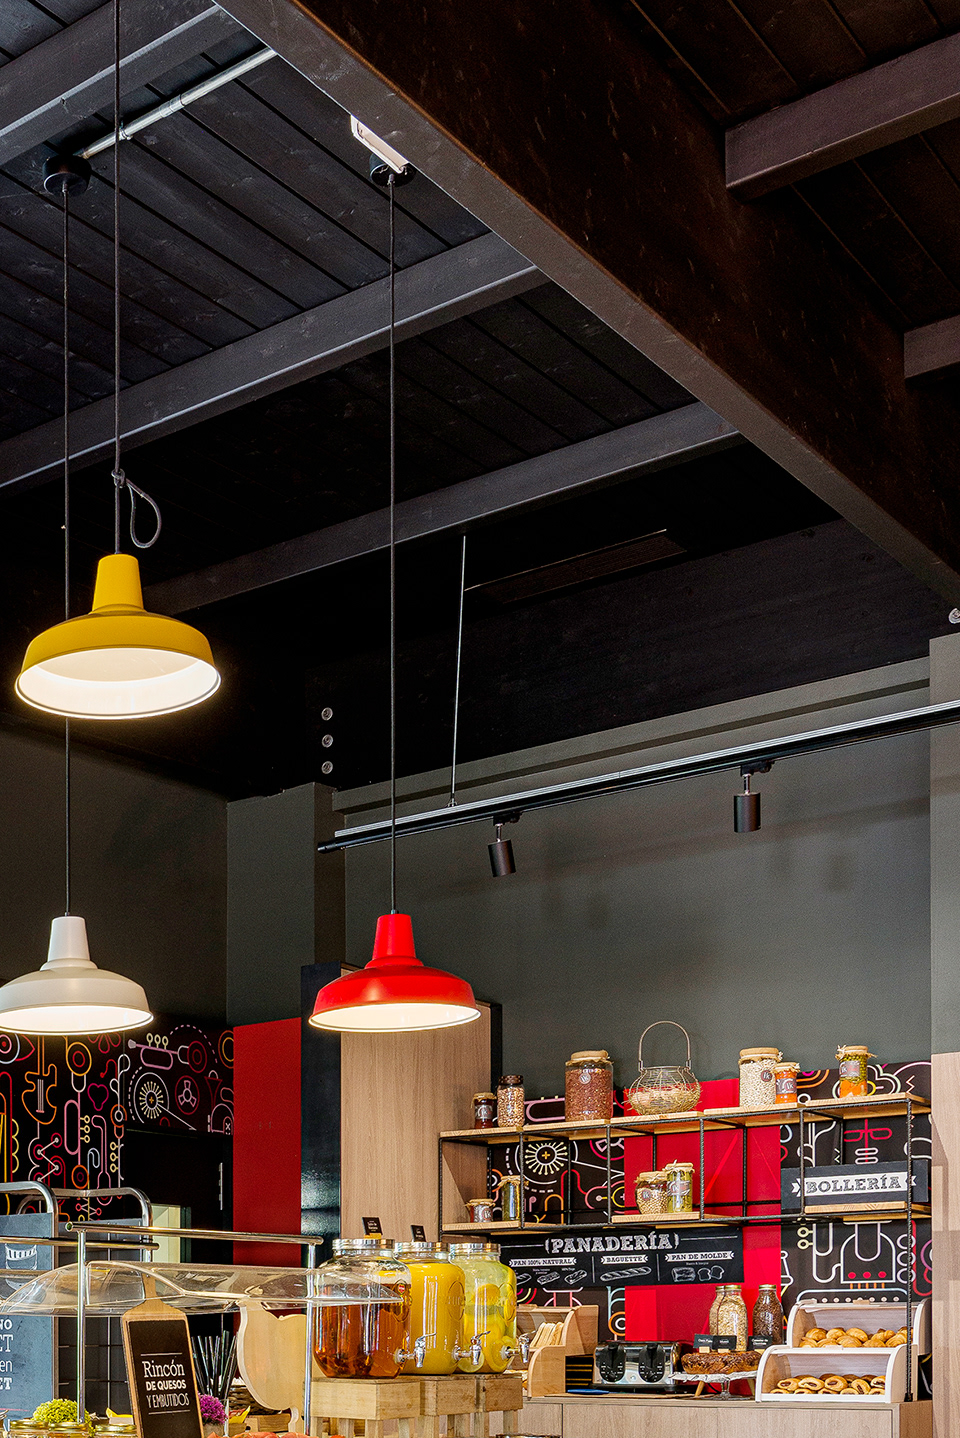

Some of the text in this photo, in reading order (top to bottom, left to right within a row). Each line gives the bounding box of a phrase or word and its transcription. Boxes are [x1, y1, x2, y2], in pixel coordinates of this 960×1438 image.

[805, 1174, 901, 1194] BOLLERÍA
[141, 1359, 185, 1378] Rincón
[145, 1380, 187, 1391] DE QUESOS
[146, 1393, 190, 1408] Y EMBUTIDOS
